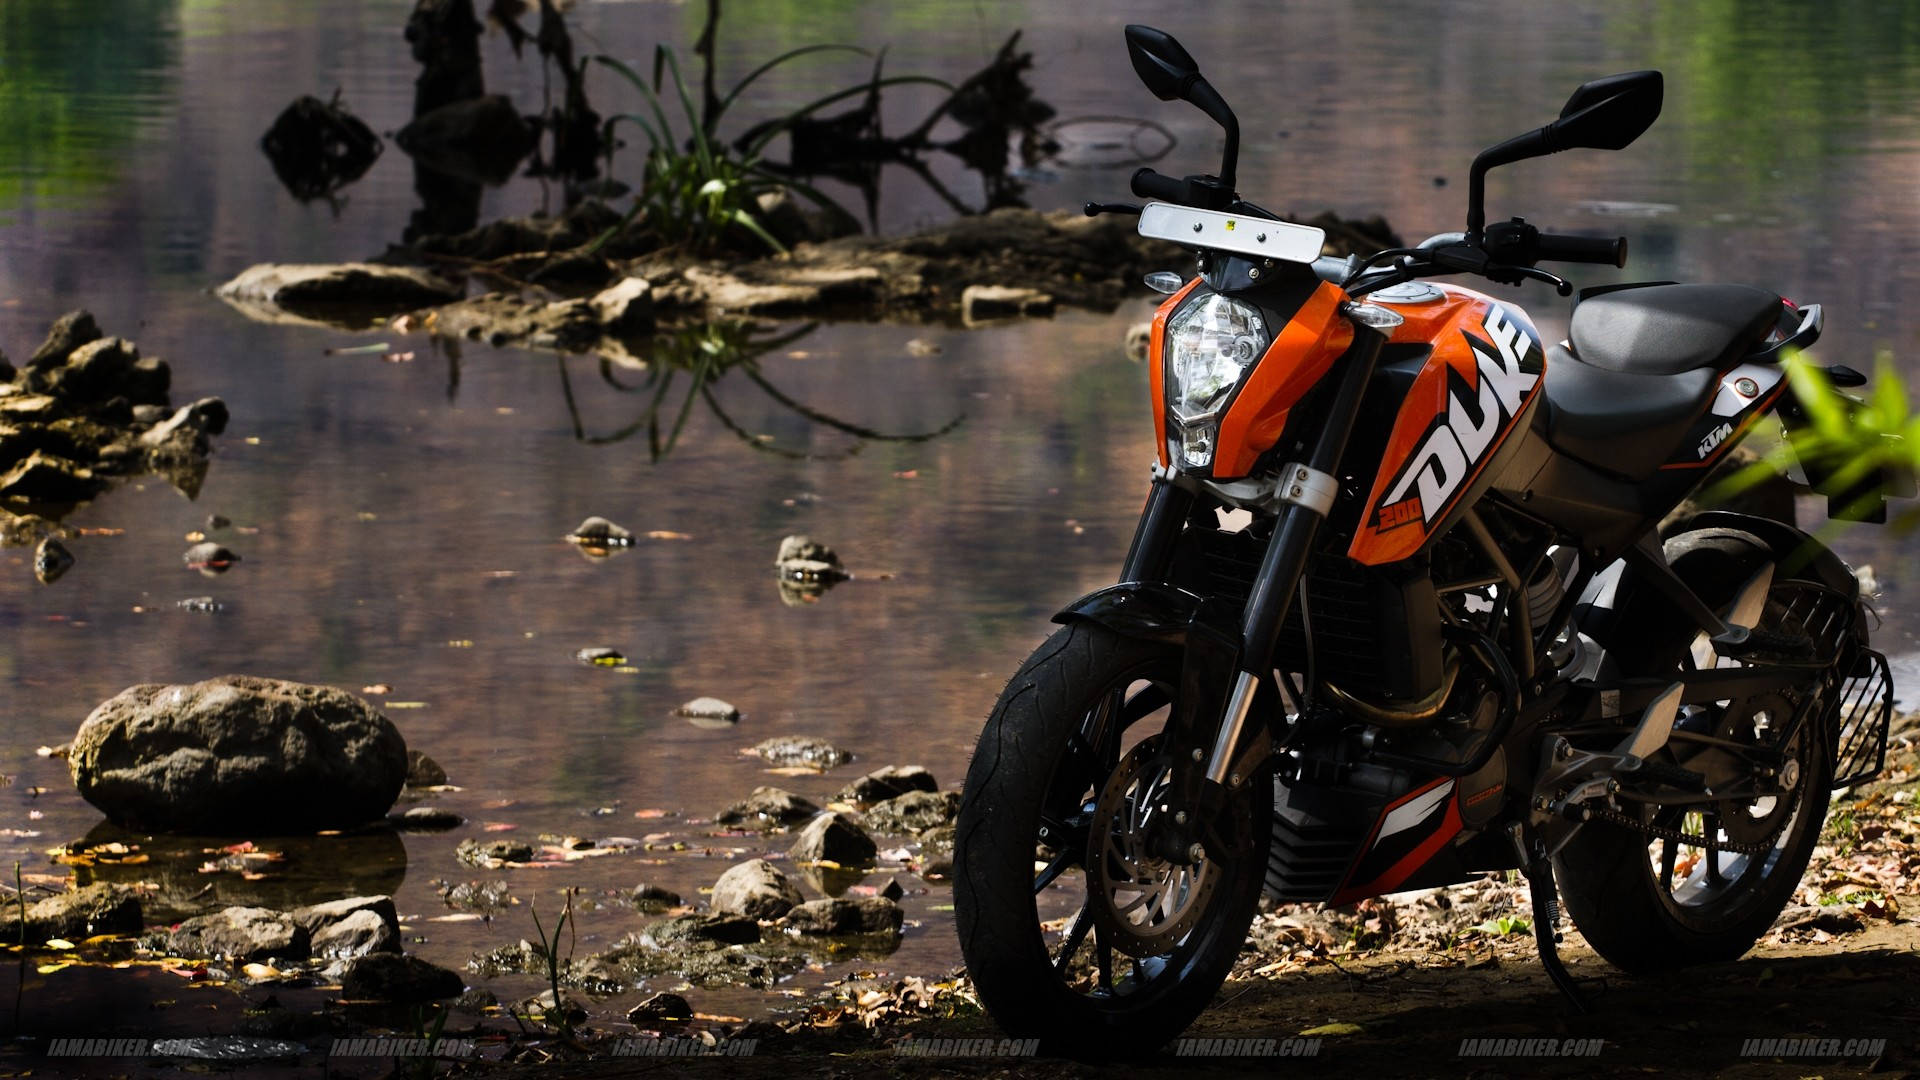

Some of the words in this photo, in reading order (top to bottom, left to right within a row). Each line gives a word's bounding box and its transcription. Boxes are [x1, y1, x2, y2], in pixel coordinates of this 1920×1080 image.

[1382, 302, 1541, 524] DUKE
[1697, 422, 1734, 460] KTM
[1378, 496, 1424, 526] 200
